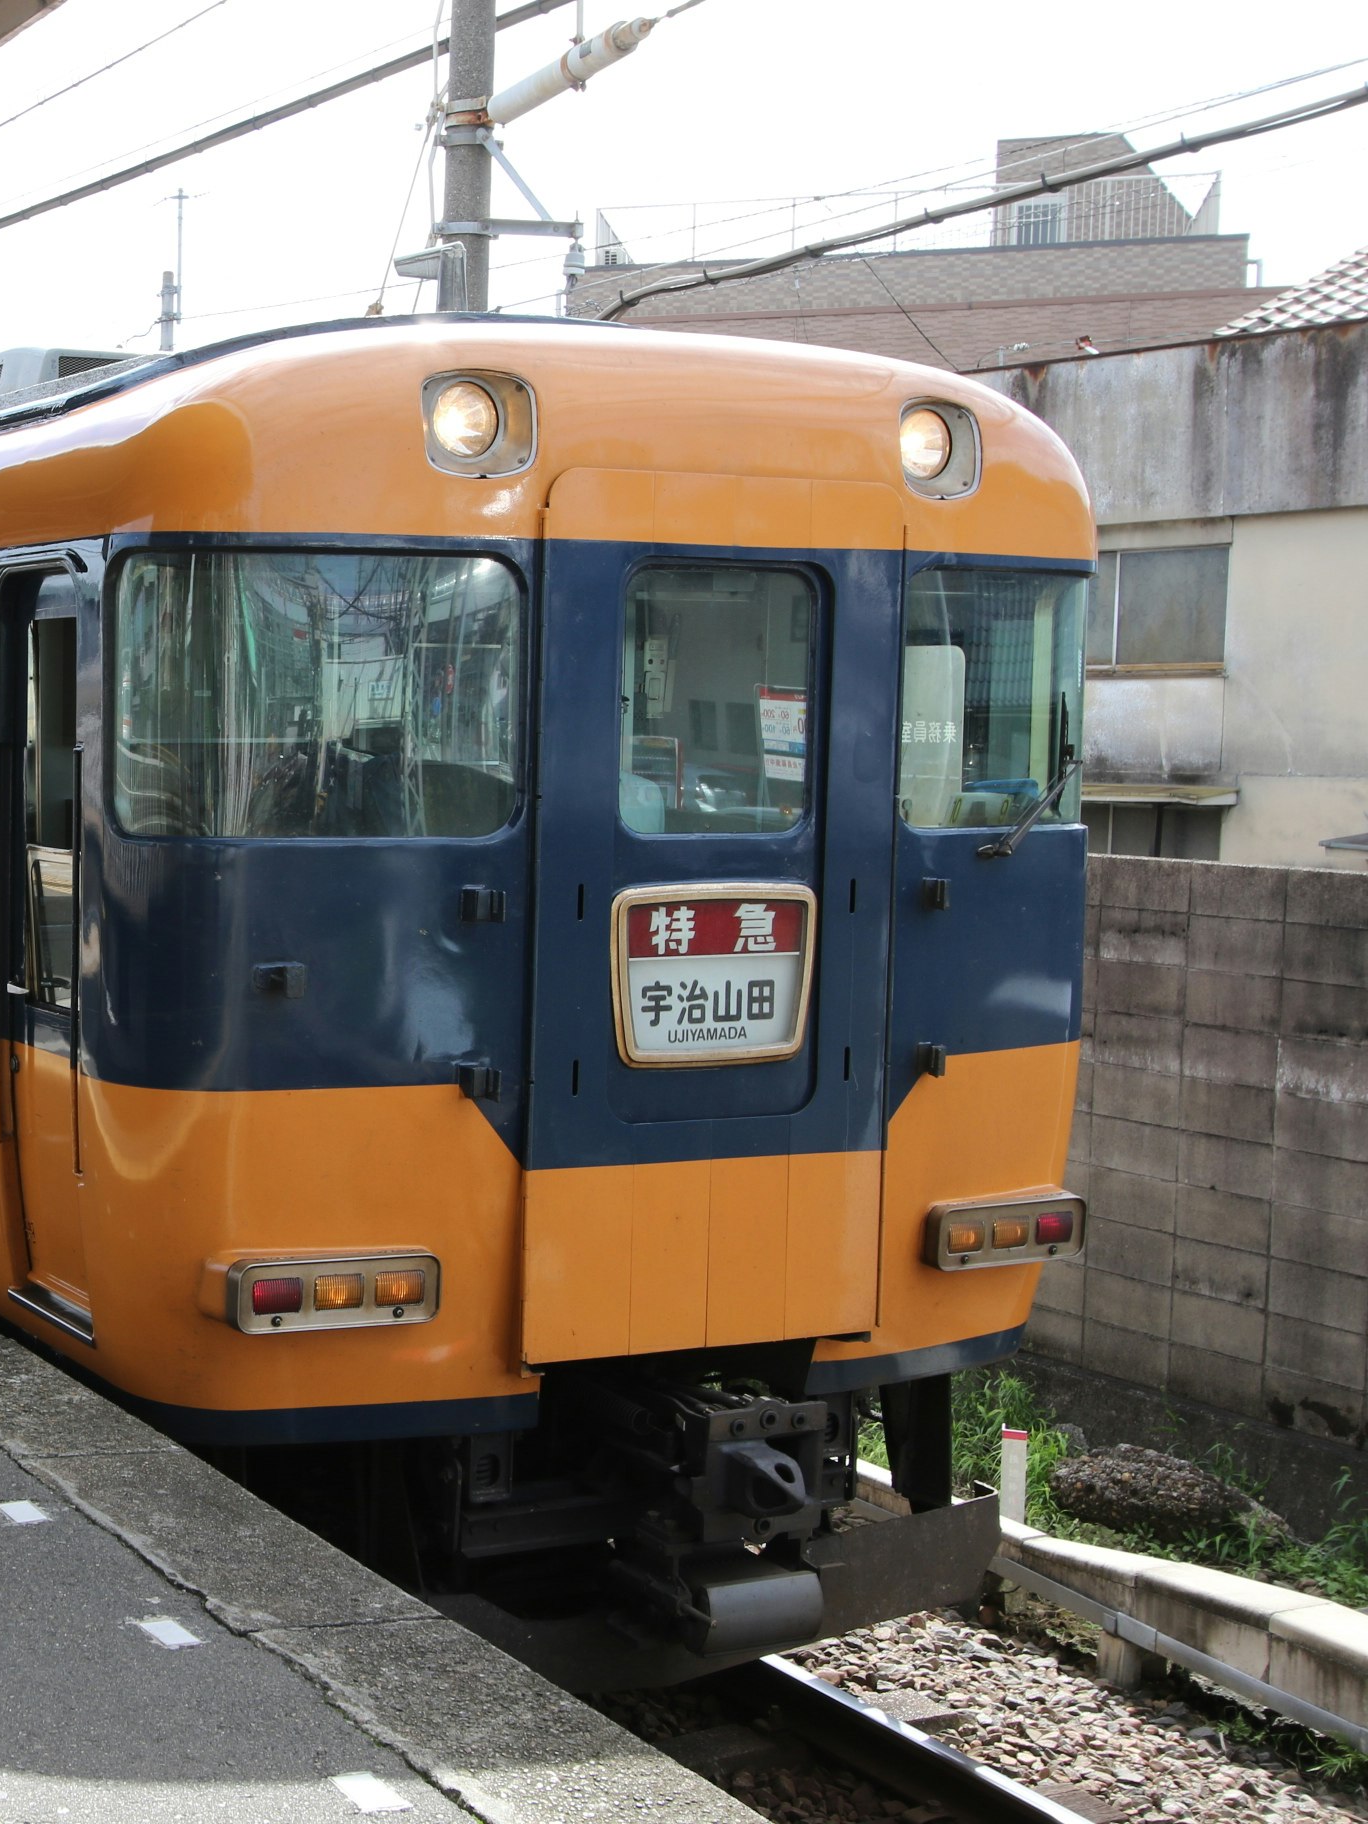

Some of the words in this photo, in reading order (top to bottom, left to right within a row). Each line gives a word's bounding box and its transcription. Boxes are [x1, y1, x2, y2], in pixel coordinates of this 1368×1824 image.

[649, 903, 777, 955] 特急
[641, 979, 775, 1027] 宇治山田
[667, 1026, 748, 1044] UJIYAMADA
